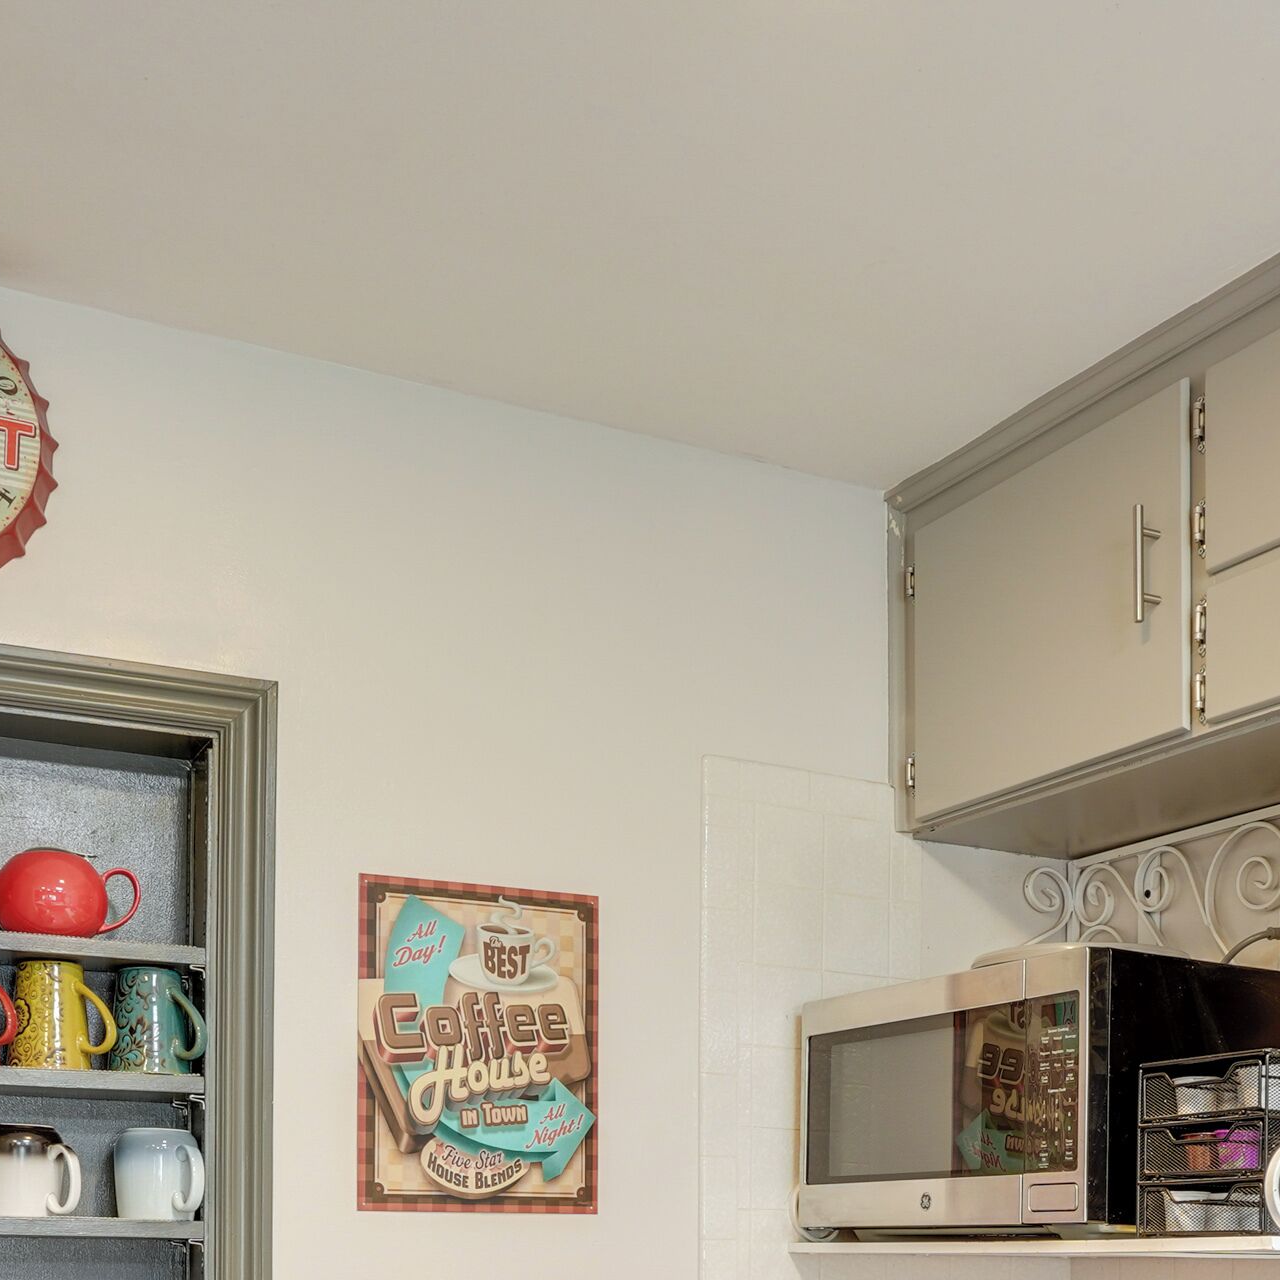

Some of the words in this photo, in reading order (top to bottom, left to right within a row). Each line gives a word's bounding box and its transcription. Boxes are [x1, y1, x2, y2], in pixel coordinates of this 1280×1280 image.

[407, 920, 438, 942] All
[483, 942, 530, 979] BEST
[374, 992, 570, 1062] Coffee
[409, 1043, 551, 1126] House
[525, 1113, 584, 1150] Night!
[540, 1103, 566, 1125] All
[427, 1151, 469, 1189] HOUSE
[474, 1159, 522, 1190] BLENDS
[441, 1144, 471, 1169] Five
[474, 1150, 503, 1170] Star
